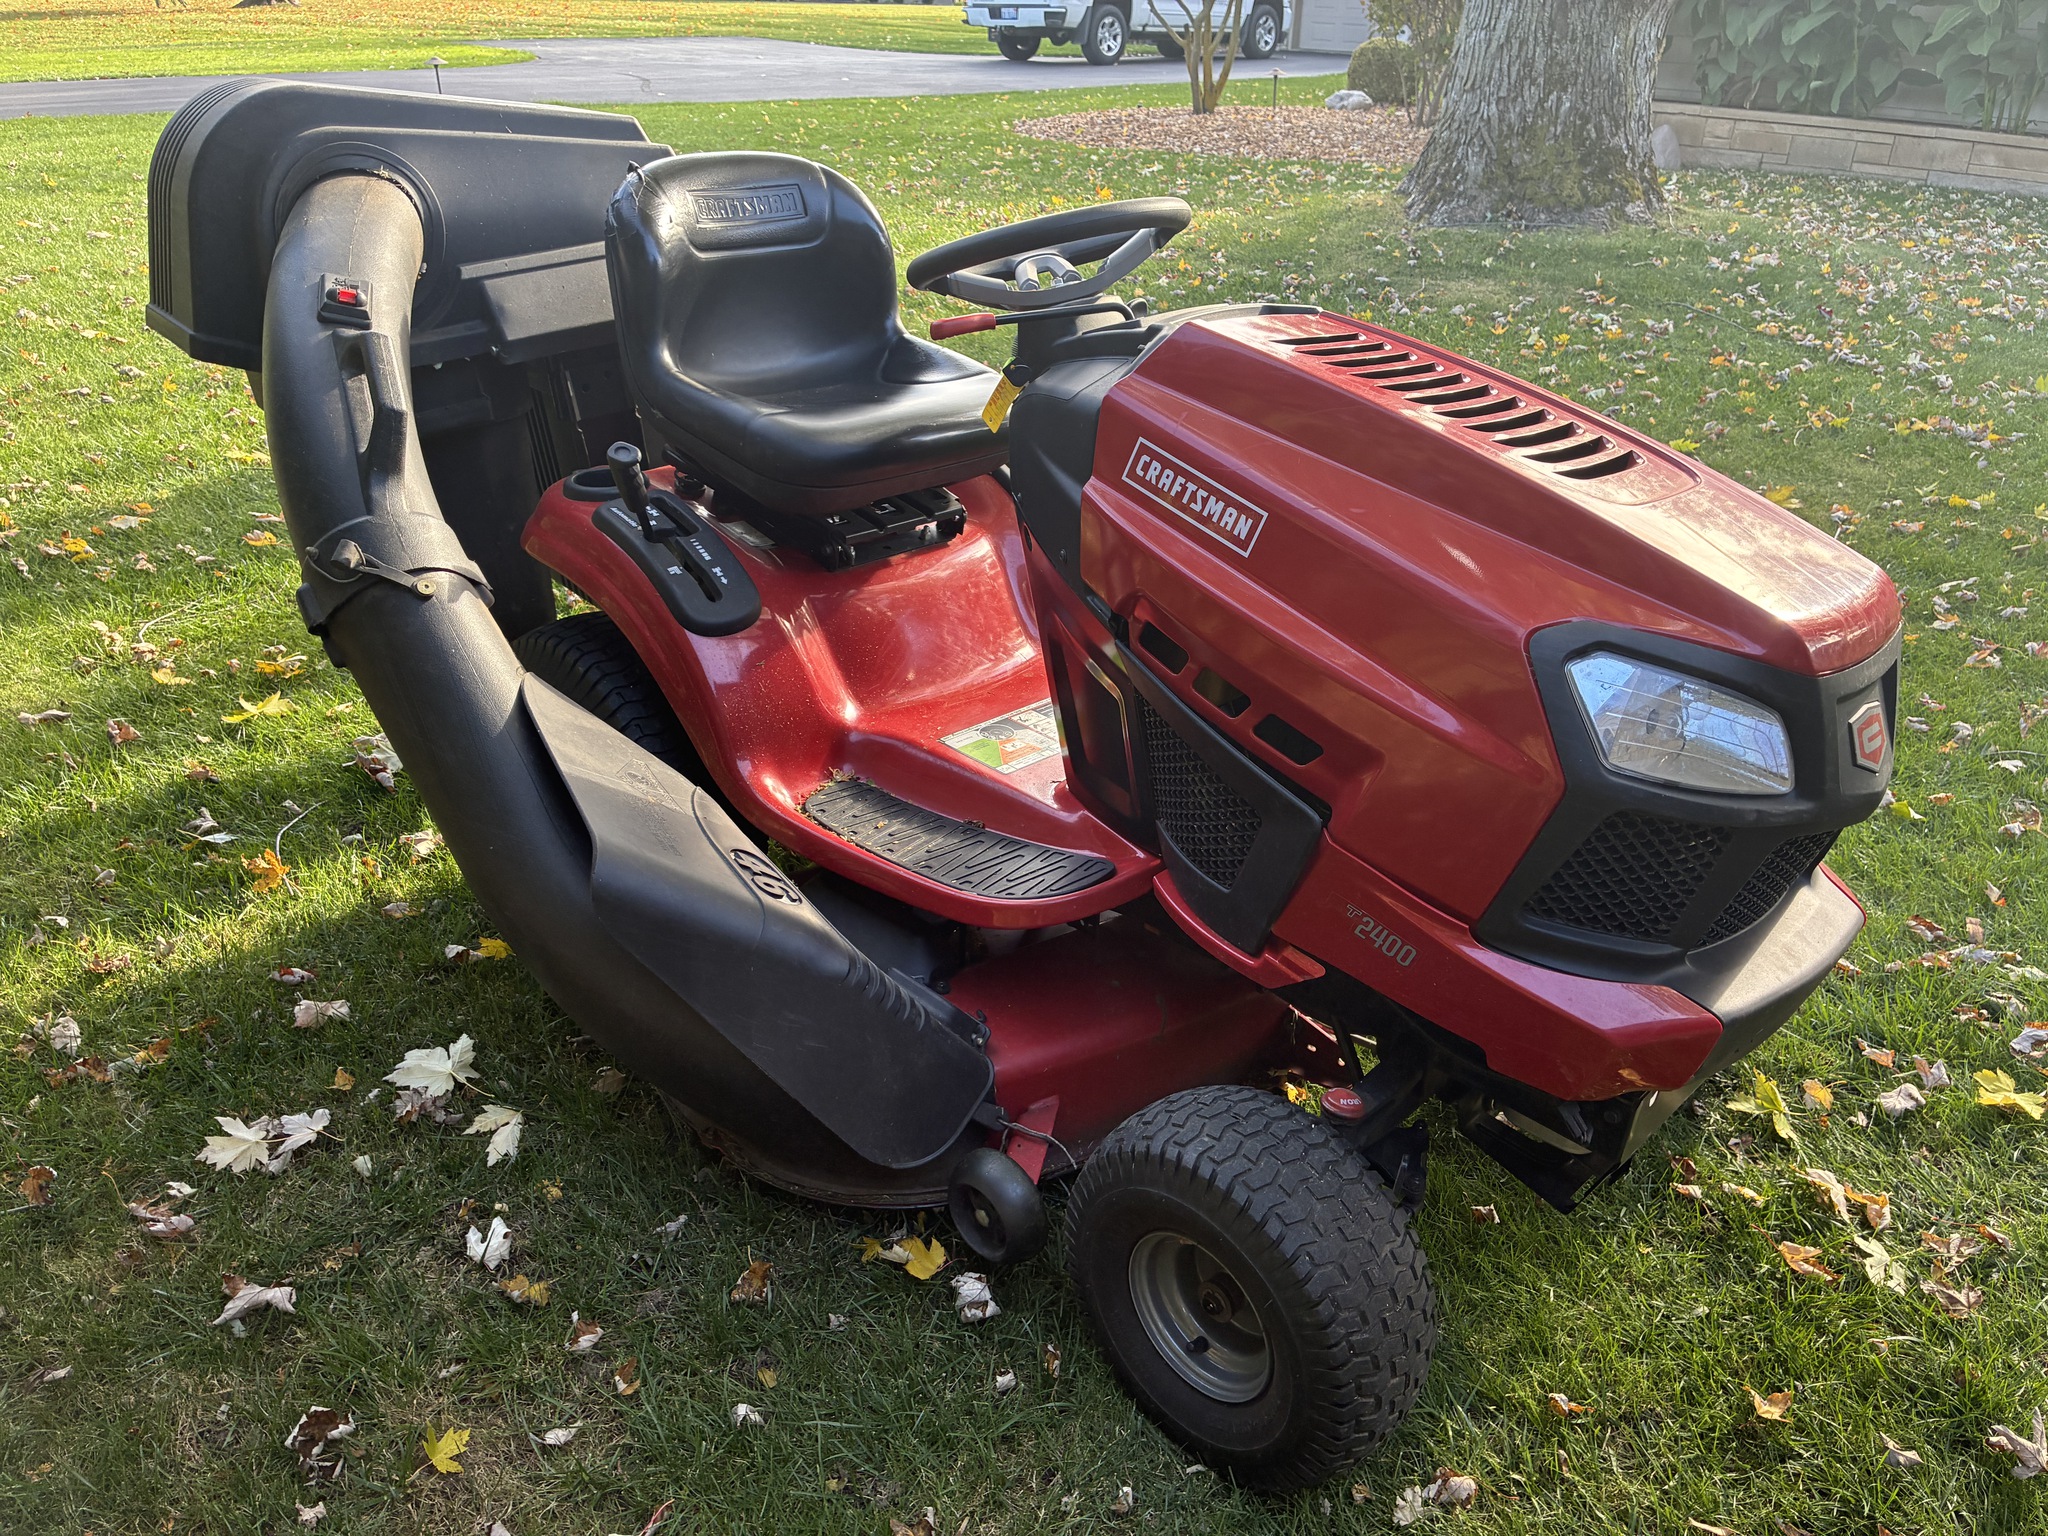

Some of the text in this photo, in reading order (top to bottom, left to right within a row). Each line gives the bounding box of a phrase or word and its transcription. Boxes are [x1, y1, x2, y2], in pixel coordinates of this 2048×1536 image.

[695, 191, 799, 219] CRAFTSMAN
[1135, 454, 1253, 541] CRAFTSMAN
[729, 848, 803, 905] 46
